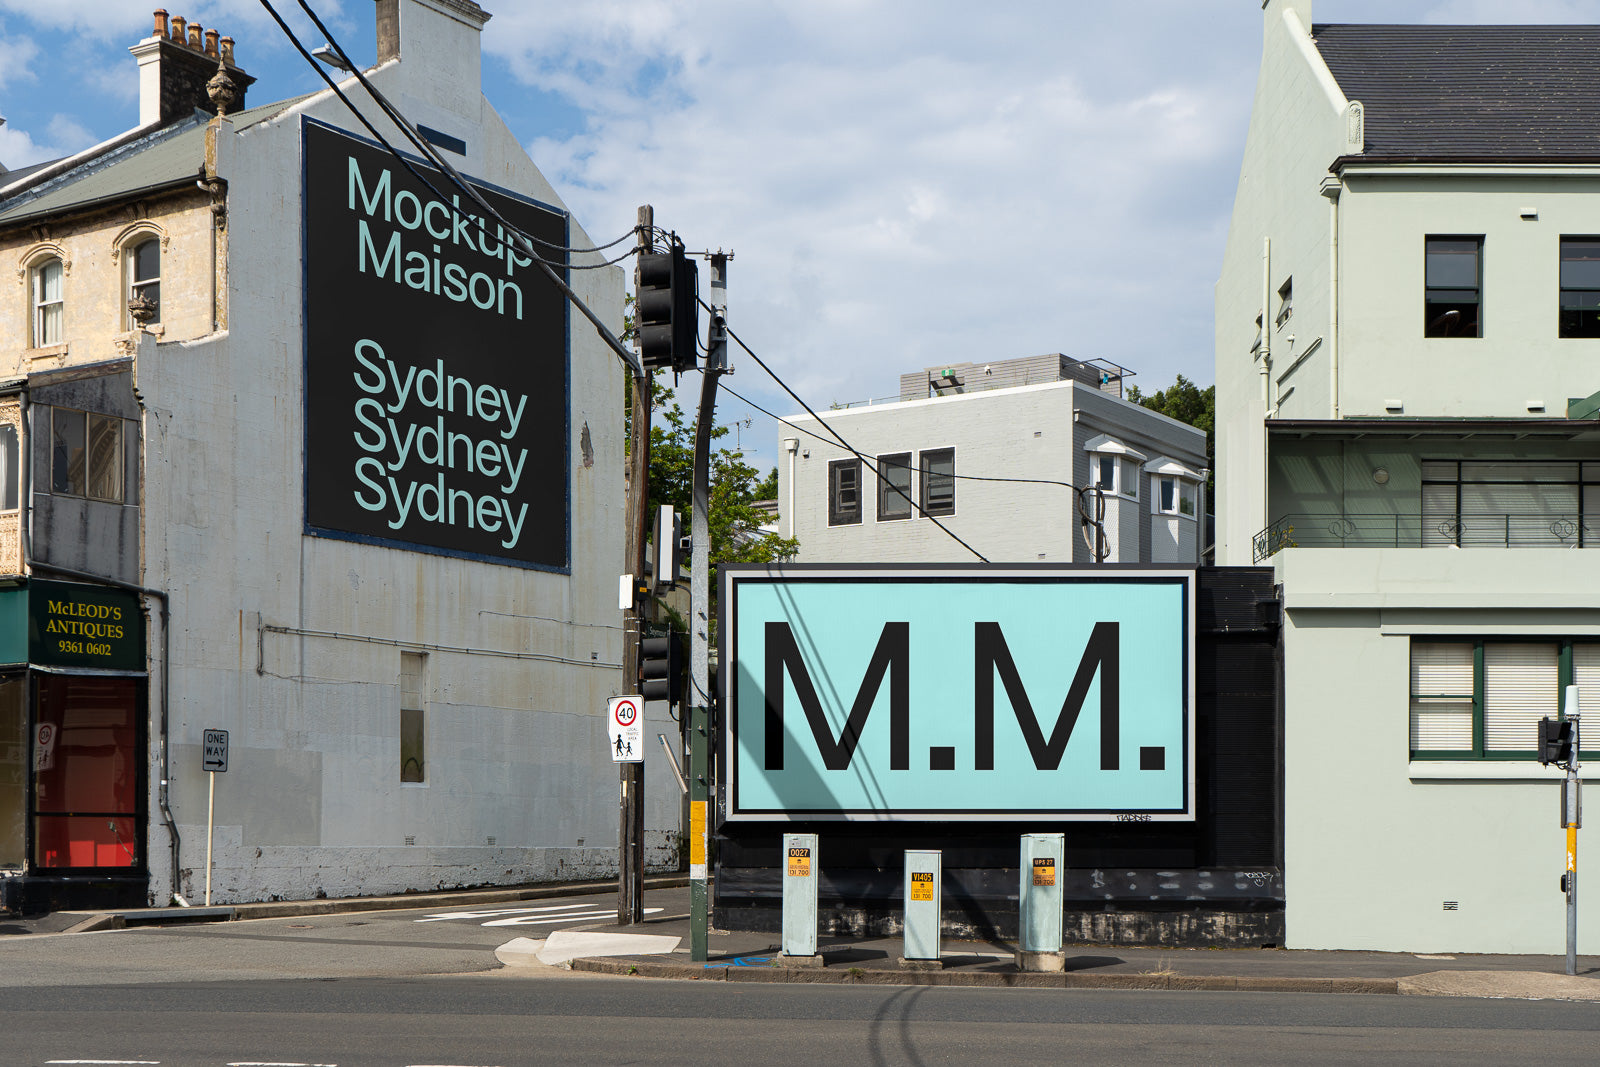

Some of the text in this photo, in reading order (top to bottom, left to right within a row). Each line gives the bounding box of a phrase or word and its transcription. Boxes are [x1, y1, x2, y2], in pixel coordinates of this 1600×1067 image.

[348, 156, 533, 276] Mockup
[358, 220, 523, 320] Maison
[353, 339, 528, 439] Sydney
[353, 398, 528, 493] Sydney
[353, 457, 529, 549] Sydney
[46, 619, 124, 639] ANTIQUES
[48, 600, 122, 620] McLEOD'S
[59, 641, 111, 656] 9361 0602
[619, 707, 634, 719] 40
[764, 621, 1166, 770] M.M.
[206, 746, 225, 757] WAY
[207, 733, 225, 744] ONE
